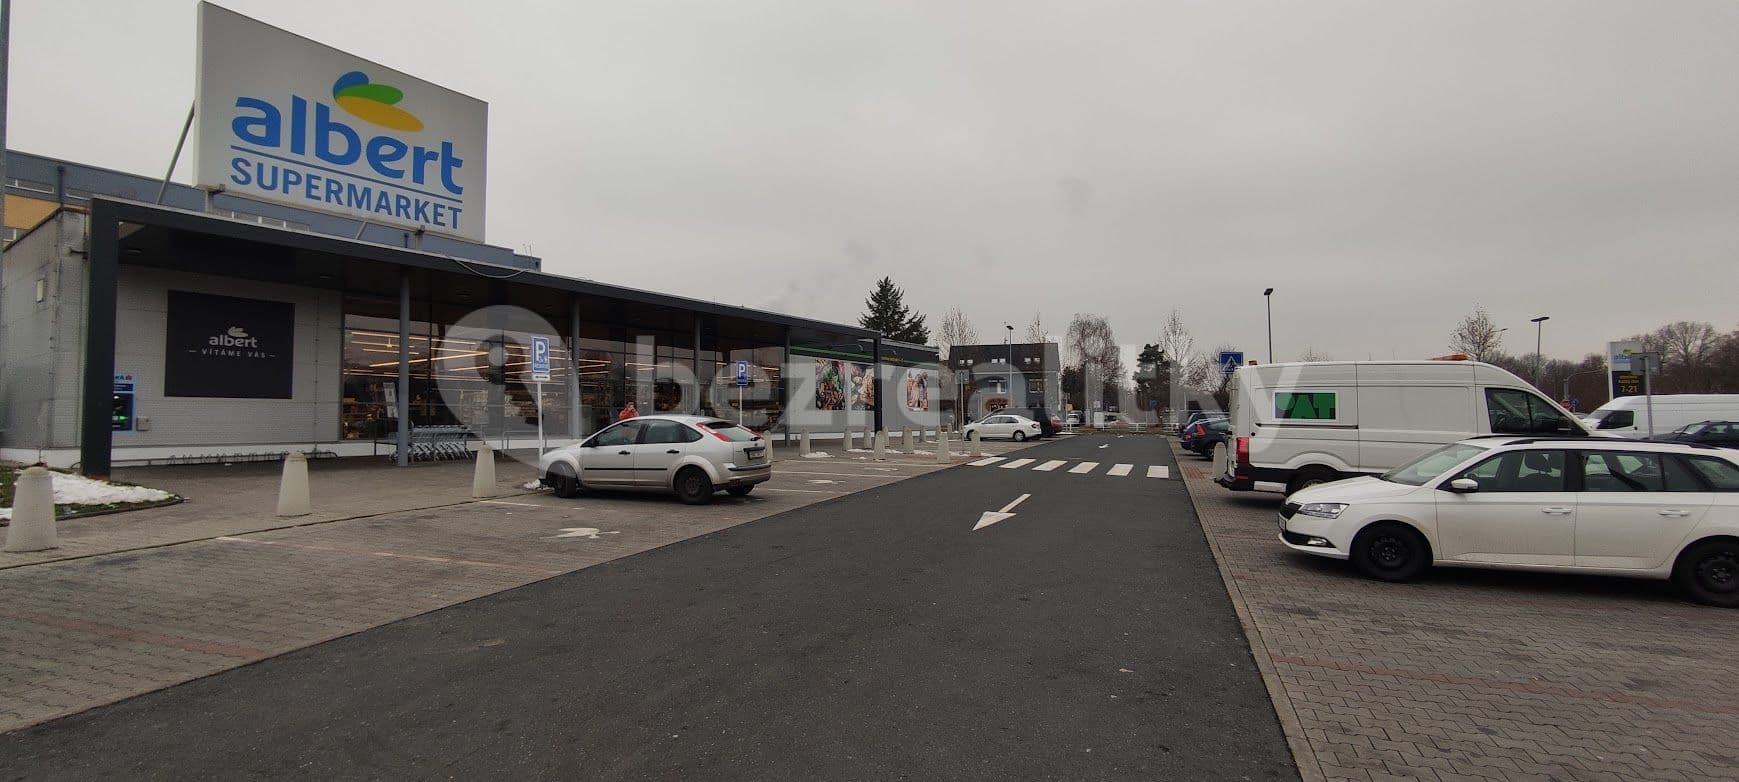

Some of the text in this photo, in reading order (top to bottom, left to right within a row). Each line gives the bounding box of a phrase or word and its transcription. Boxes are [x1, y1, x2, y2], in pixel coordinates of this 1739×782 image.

[231, 94, 464, 195] albert
[230, 157, 463, 230] SUPERMARKET
[208, 334, 258, 348] albert
[535, 341, 546, 361] P
[738, 363, 746, 378] P
[1620, 385, 1638, 393] 7-21
